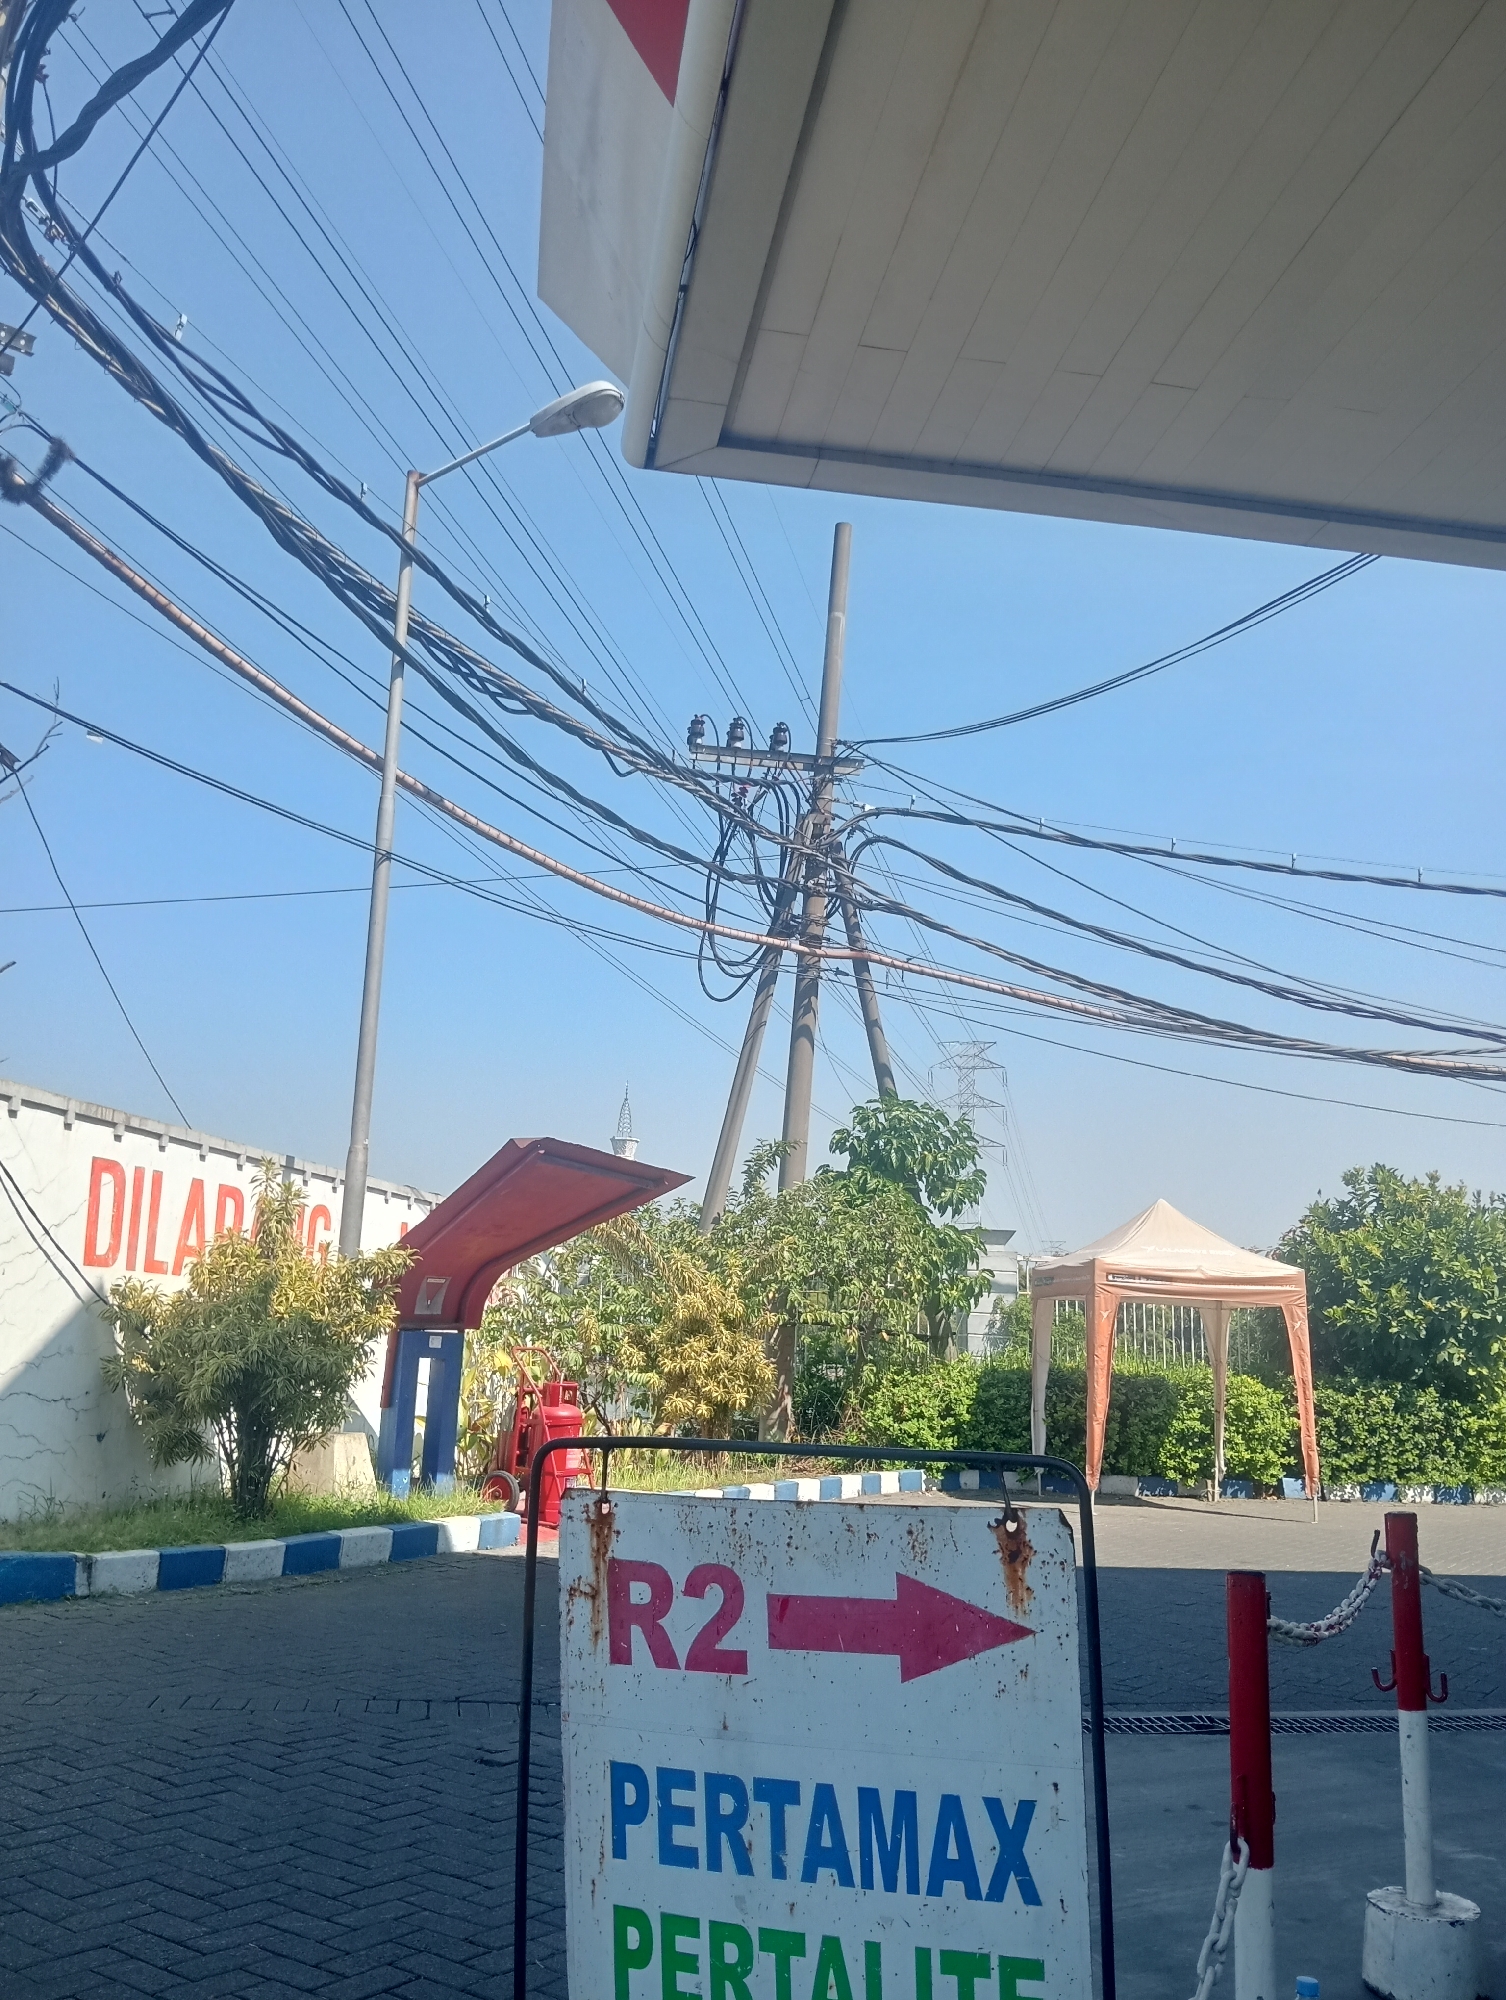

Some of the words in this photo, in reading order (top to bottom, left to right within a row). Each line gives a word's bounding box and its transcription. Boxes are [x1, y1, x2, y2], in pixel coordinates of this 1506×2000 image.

[83, 1156, 333, 1277] DILARG
[607, 1558, 749, 1675] R2
[609, 1759, 1043, 1907] PERTAMAX
